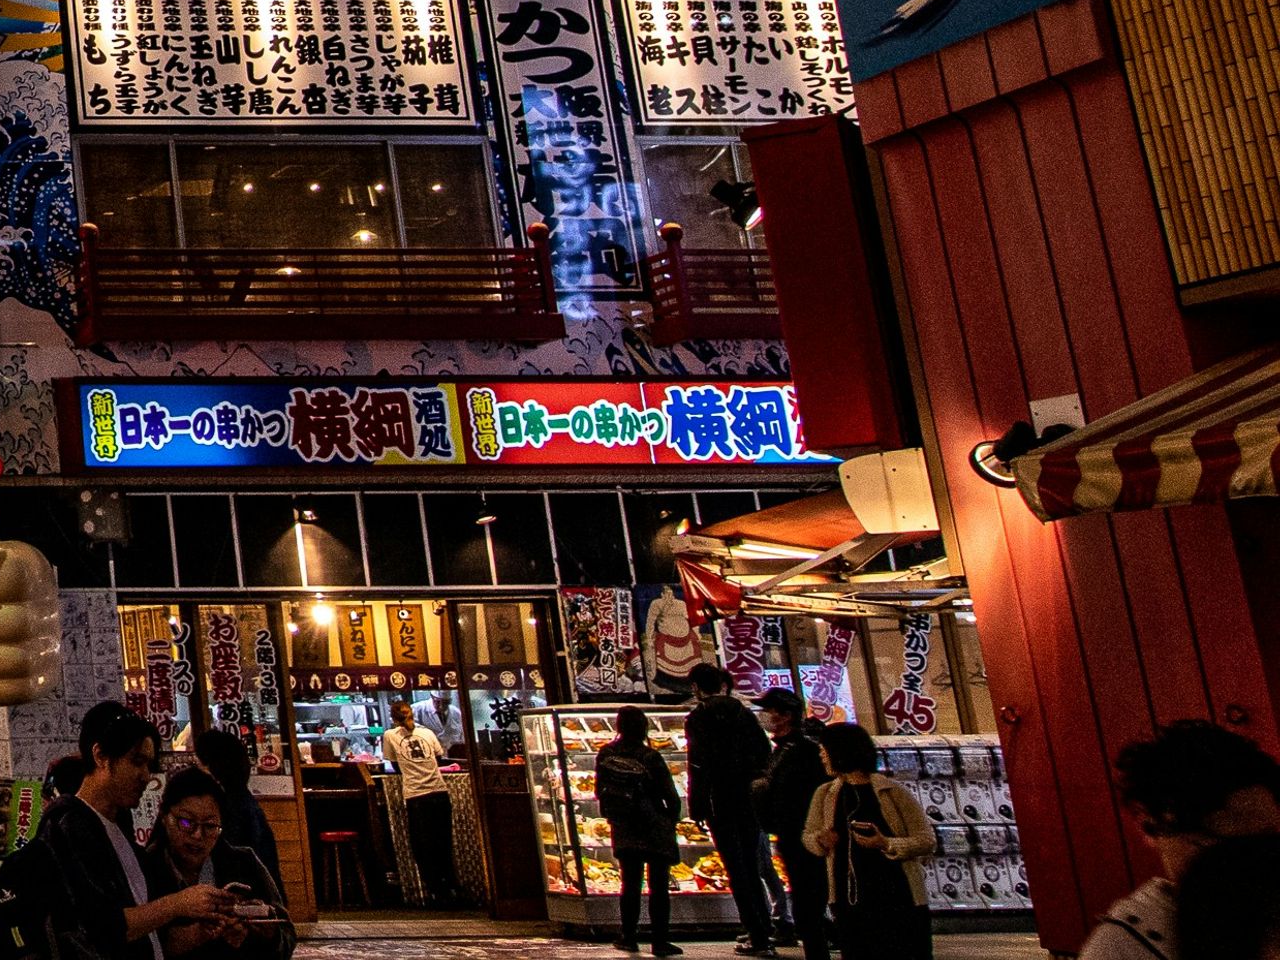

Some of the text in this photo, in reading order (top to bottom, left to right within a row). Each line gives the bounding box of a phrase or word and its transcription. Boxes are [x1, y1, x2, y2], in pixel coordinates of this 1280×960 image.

[83, 33, 112, 115] もち
[110, 33, 141, 115] うずら玉子
[135, 33, 168, 115] 紅しょうが
[161, 33, 191, 115] にんにく
[189, 33, 220, 115] 玉ねぎ
[215, 33, 247, 115] 山芋
[243, 33, 274, 115] しし唐
[269, 33, 302, 115] れんこん
[294, 33, 327, 115] 銀杏
[322, 33, 354, 115] 白ねぎ
[349, 33, 381, 115] さつま芋
[375, 33, 408, 115] じゃが芋
[401, 33, 434, 115] 茄子
[428, 33, 460, 115] 椎茸
[637, 35, 673, 115] 海老
[666, 35, 701, 115] キス
[691, 35, 727, 115] 貝柱
[716, 35, 751, 115] サーモン
[743, 35, 777, 115] たこ
[768, 35, 805, 115] いか
[821, 35, 856, 115] ホルモン
[90, 391, 119, 462] 新世界
[119, 401, 286, 450] 日本一の串かつ
[287, 388, 413, 462] 横綱
[413, 390, 453, 459] 酒処
[470, 390, 500, 461] 新世界
[500, 401, 663, 450] 日本一の串かつ
[666, 388, 791, 461] 横綱
[884, 690, 935, 732] 45
